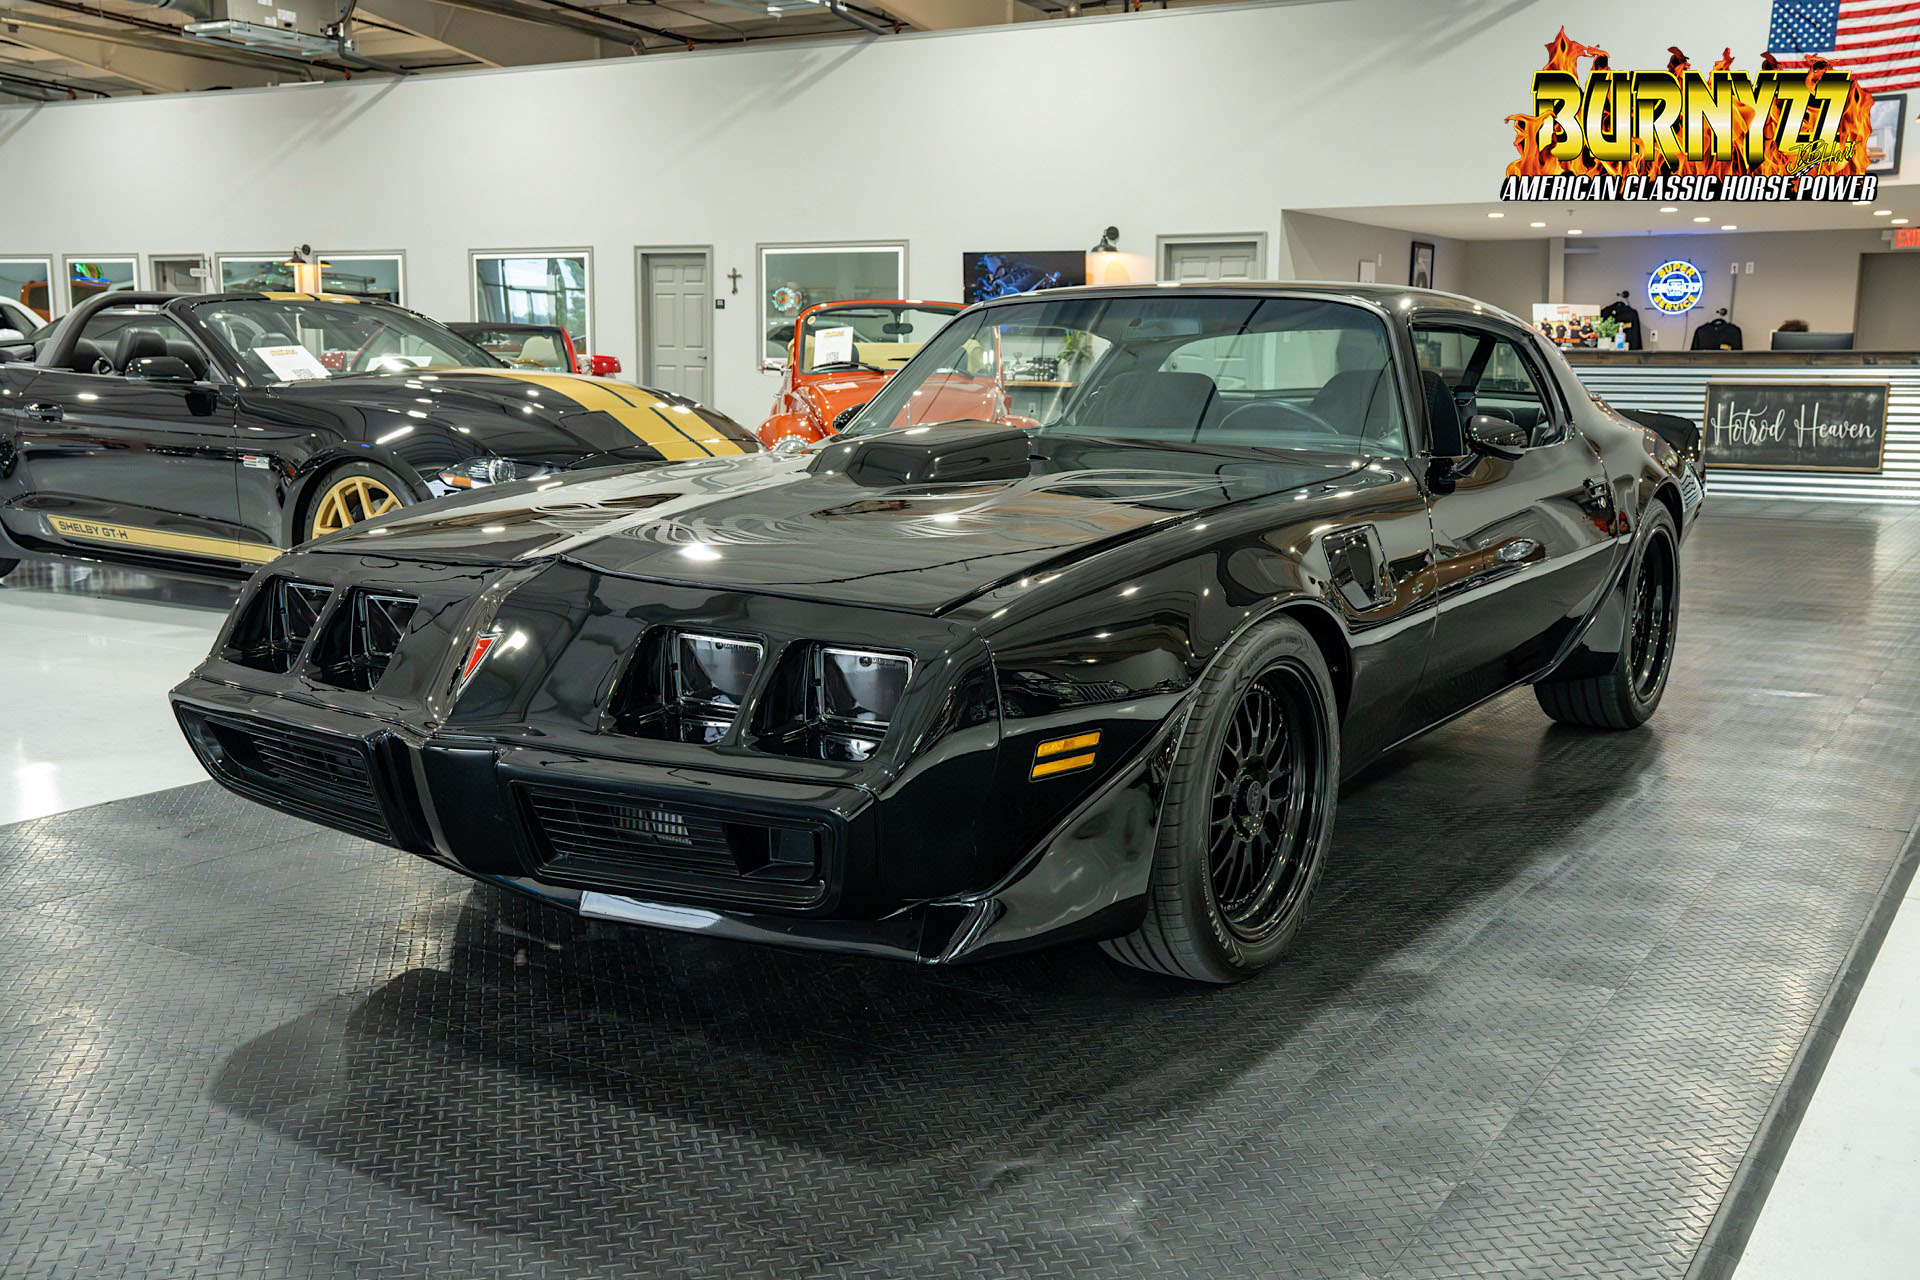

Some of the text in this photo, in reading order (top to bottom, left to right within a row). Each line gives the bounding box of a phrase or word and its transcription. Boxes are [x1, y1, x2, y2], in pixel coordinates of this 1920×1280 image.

[1658, 263, 1695, 278] SUPER
[1653, 295, 1696, 311] SERVICE
[1711, 401, 1877, 448] Hotrod Heaven
[59, 520, 129, 540] SHELBY GT-H
